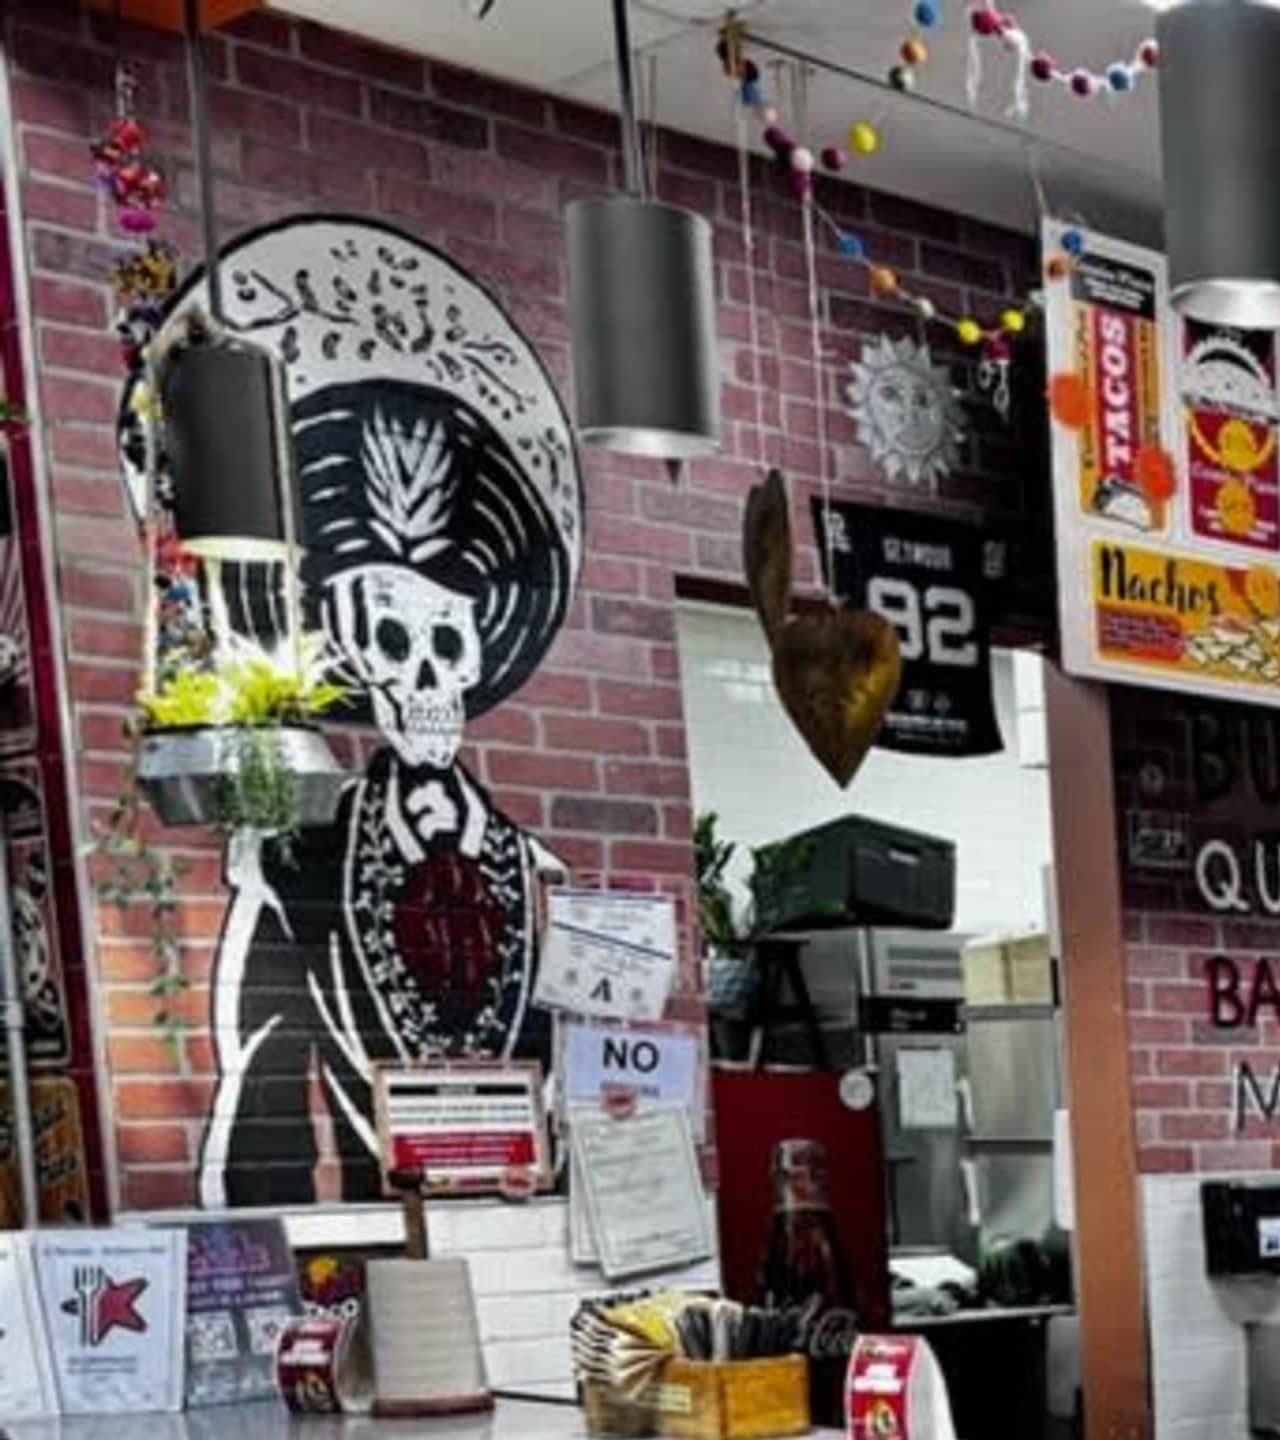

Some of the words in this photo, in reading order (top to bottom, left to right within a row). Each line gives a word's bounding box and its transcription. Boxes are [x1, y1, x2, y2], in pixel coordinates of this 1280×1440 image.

[1102, 312, 1132, 470] TACOS
[1100, 545, 1220, 614] Nachos
[866, 576, 979, 667] 92
[602, 1036, 660, 1074] NO
